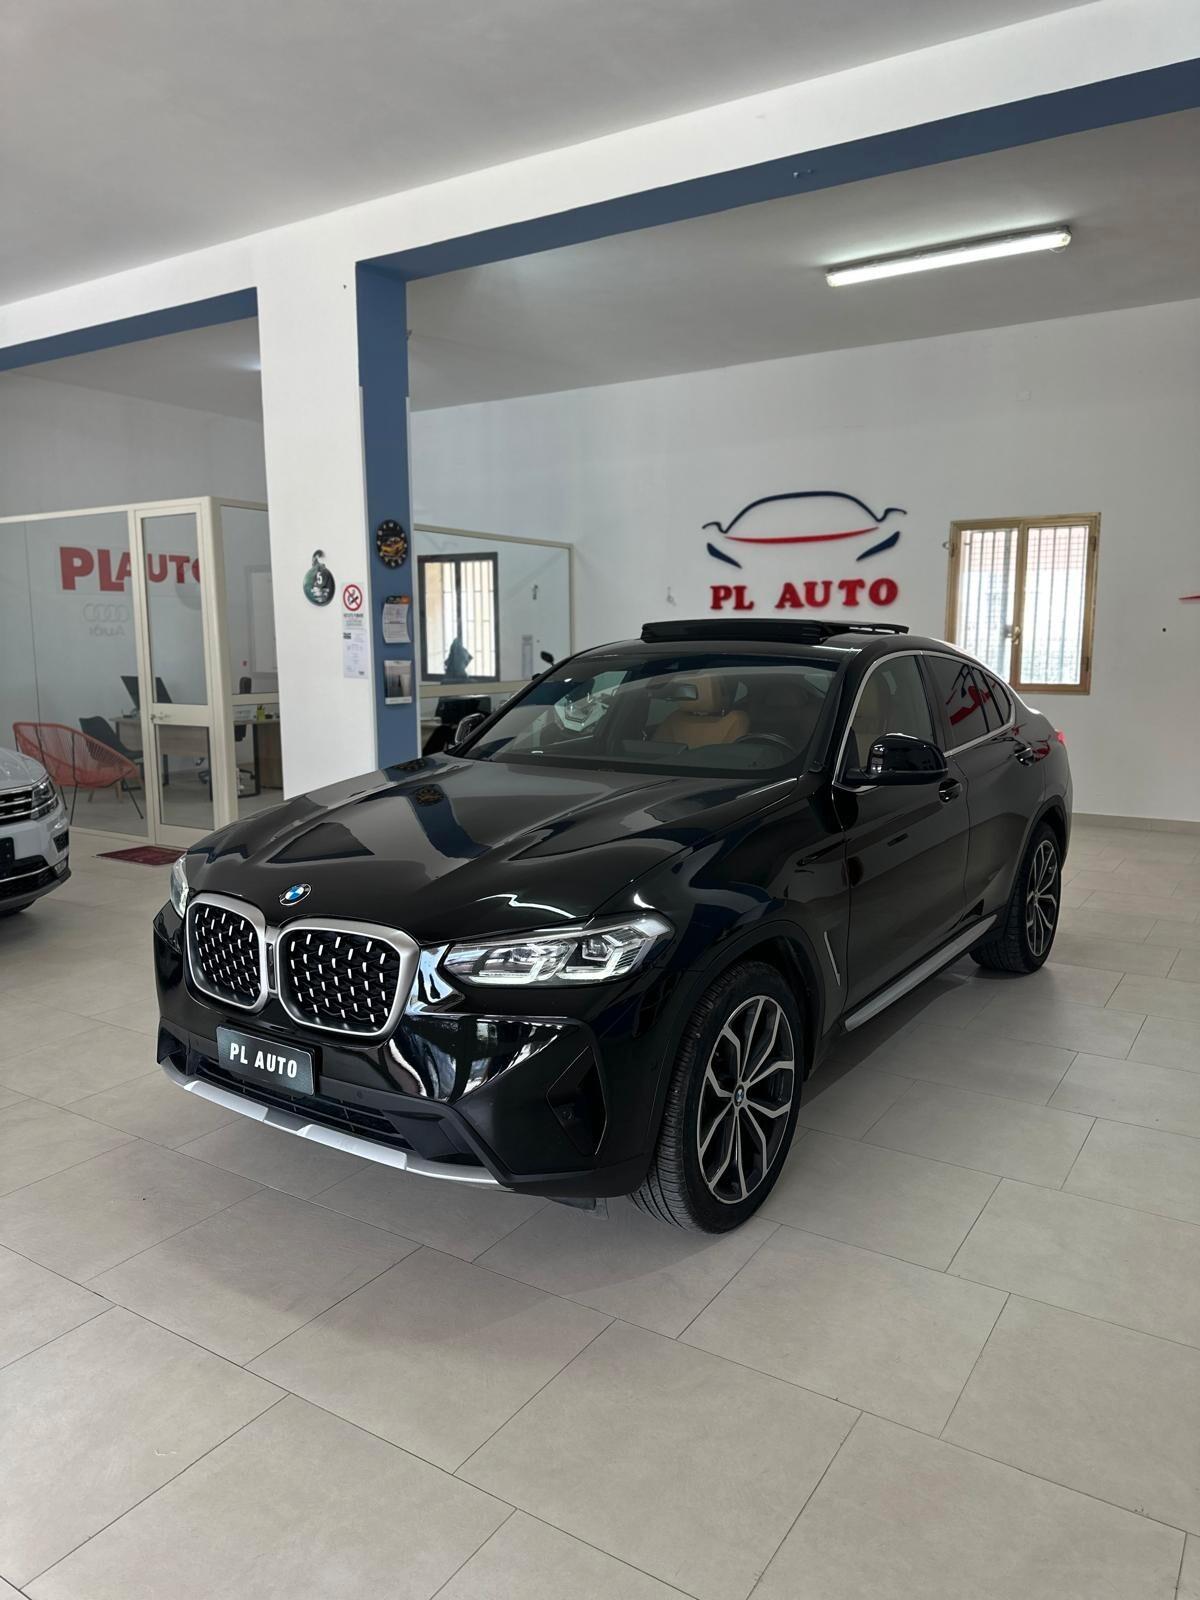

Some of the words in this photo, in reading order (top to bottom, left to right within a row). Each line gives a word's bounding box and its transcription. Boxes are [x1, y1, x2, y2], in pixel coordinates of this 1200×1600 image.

[710, 584, 754, 611] PL
[775, 577, 899, 610] AUTO
[229, 1042, 249, 1065] PL
[254, 1050, 298, 1078] AUTO
